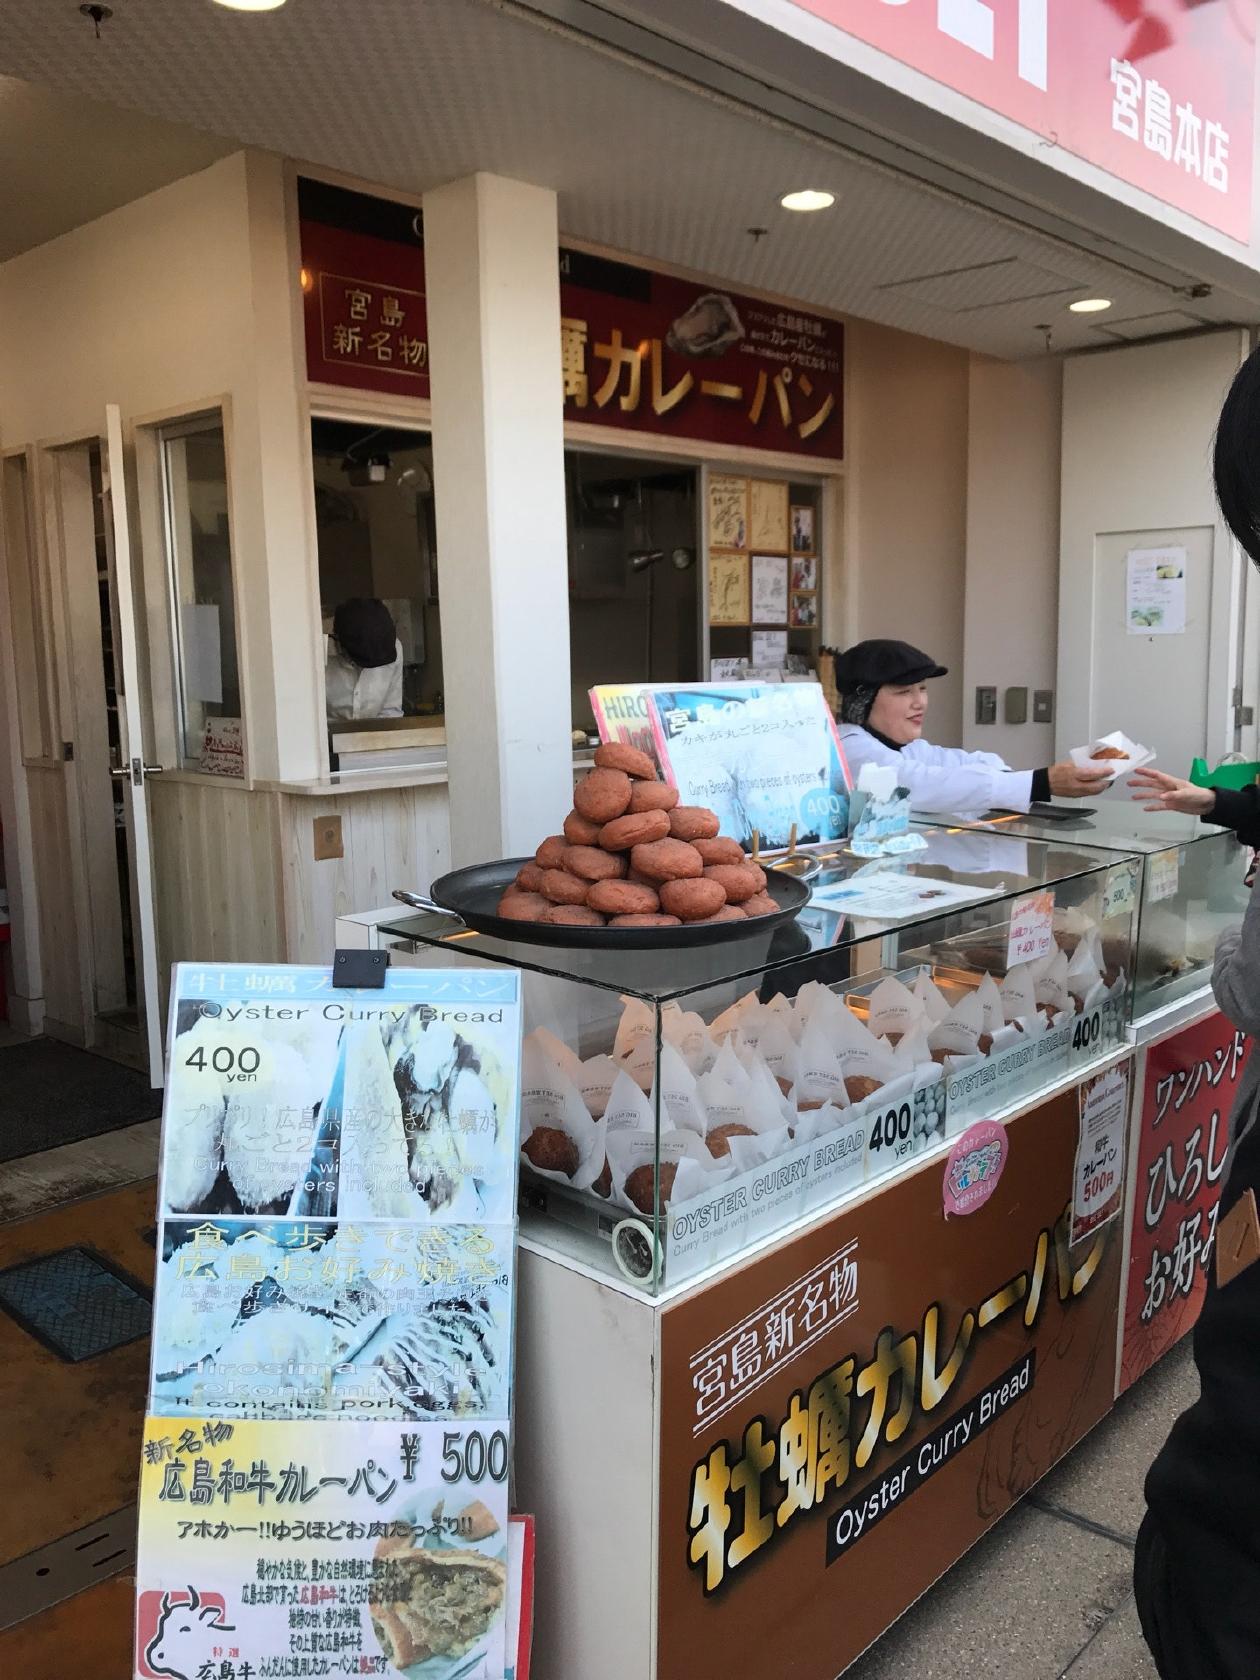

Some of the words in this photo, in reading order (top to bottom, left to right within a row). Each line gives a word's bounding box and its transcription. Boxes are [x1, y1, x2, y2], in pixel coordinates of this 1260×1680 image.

[1110, 57, 1230, 194] 宮島本店
[345, 287, 405, 328] 宮島
[333, 323, 428, 367] 新名物
[199, 1001, 310, 1022] Oyster
[322, 1003, 407, 1024] Curry
[418, 1006, 504, 1024] Bread
[1072, 1011, 1101, 1051] 400
[184, 1046, 262, 1074] 400
[226, 1072, 258, 1083] yen
[950, 1063, 997, 1101] OYSTER
[998, 1044, 1037, 1076] CURRY
[1037, 1027, 1072, 1058] BREAD
[1153, 1030, 1247, 1126] ワンハンド
[868, 1102, 912, 1152] 400
[894, 1140, 913, 1160] yen
[1083, 1146, 1118, 1180] カレーパン
[1144, 1112, 1229, 1227] ひろし
[672, 1186, 748, 1242] OYSTER
[751, 1158, 811, 1202] CURRY
[813, 1128, 866, 1172] BREAD
[1083, 1170, 1115, 1203] 500円
[186, 1221, 496, 1256] 食べ歩きできる
[673, 1238, 701, 1257] Curry
[702, 1221, 730, 1243] Bread
[731, 1212, 750, 1229] with
[175, 1252, 503, 1286] 広島お好み焼き
[692, 1257, 859, 1418] 宮島新名物
[202, 1380, 460, 1401] okonomiyaki
[205, 1400, 329, 1411] contains
[143, 1421, 234, 1464] 新名物
[399, 1431, 422, 1481] ¥
[439, 1429, 510, 1483] 500
[834, 1469, 910, 1547] Oyster
[916, 1419, 972, 1475] Curry
[978, 1361, 1030, 1423] Bread
[158, 1457, 399, 1505] 広島和牛カレーパン
[195, 1659, 257, 1680] 広島牛
